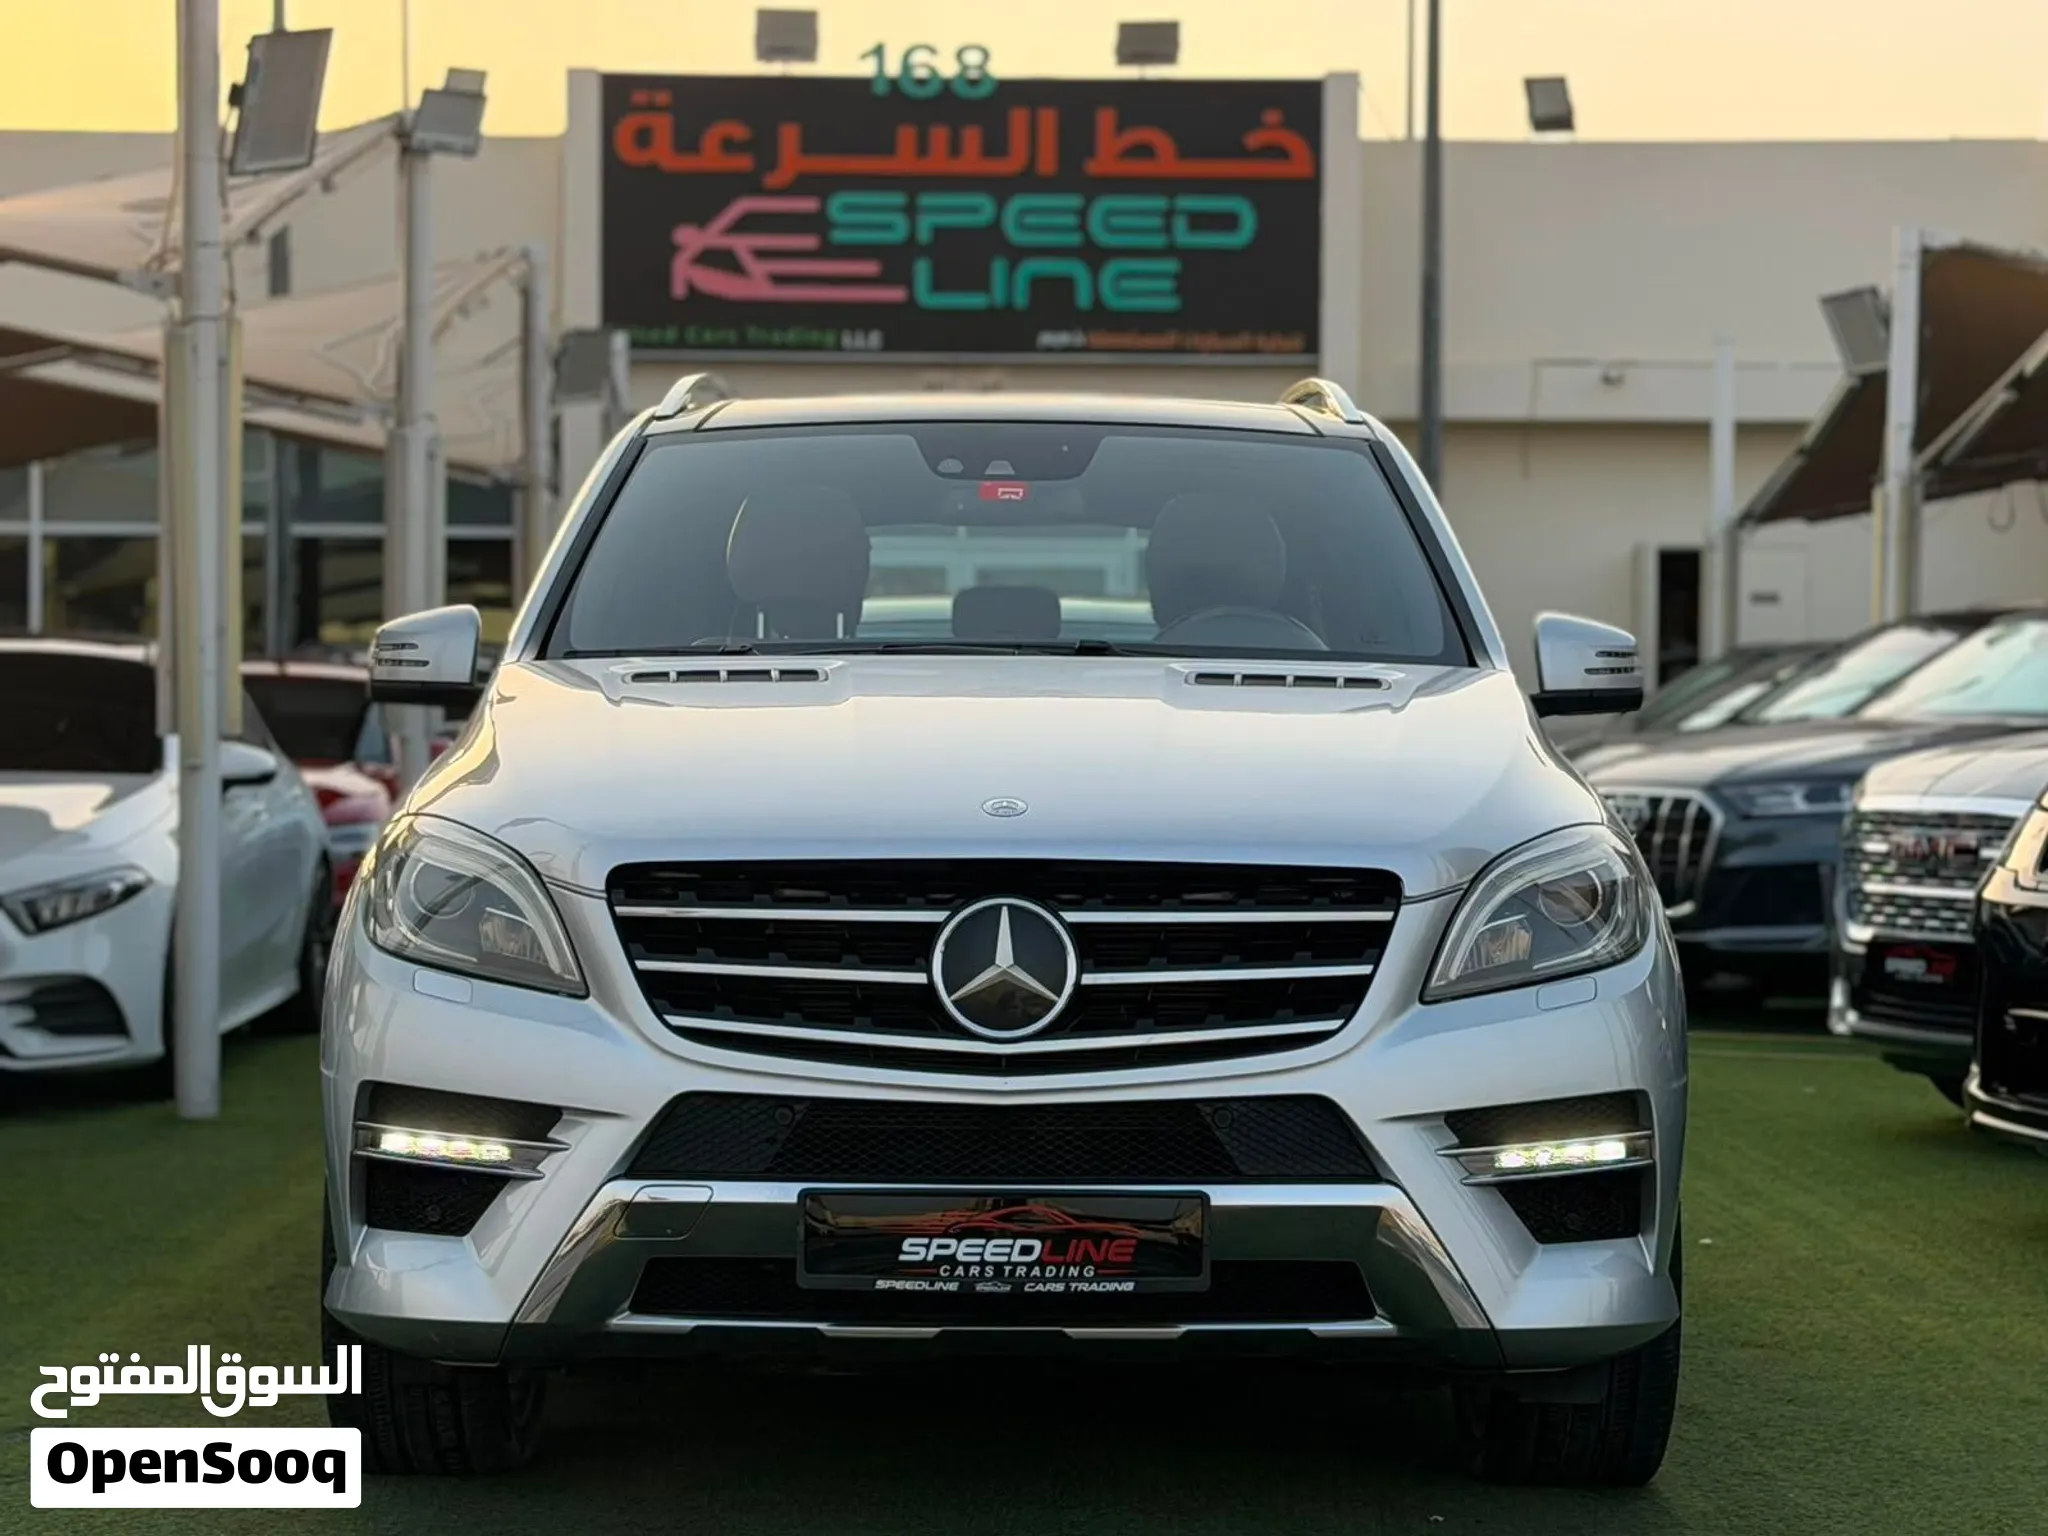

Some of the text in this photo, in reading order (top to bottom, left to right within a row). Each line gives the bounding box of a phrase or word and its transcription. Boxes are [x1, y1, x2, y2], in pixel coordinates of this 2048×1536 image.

[860, 43, 997, 99] 168
[613, 90, 1315, 188] خط السرعة
[826, 191, 1258, 249] SPEED
[912, 256, 1182, 311] LINE
[898, 1237, 1139, 1264] SPEEDLINE
[939, 1265, 1096, 1279] CARS TRADING
[874, 1279, 960, 1292] SPEEDLINE
[1024, 1281, 1066, 1293] CARS
[1068, 1281, 1135, 1293] TRADING
